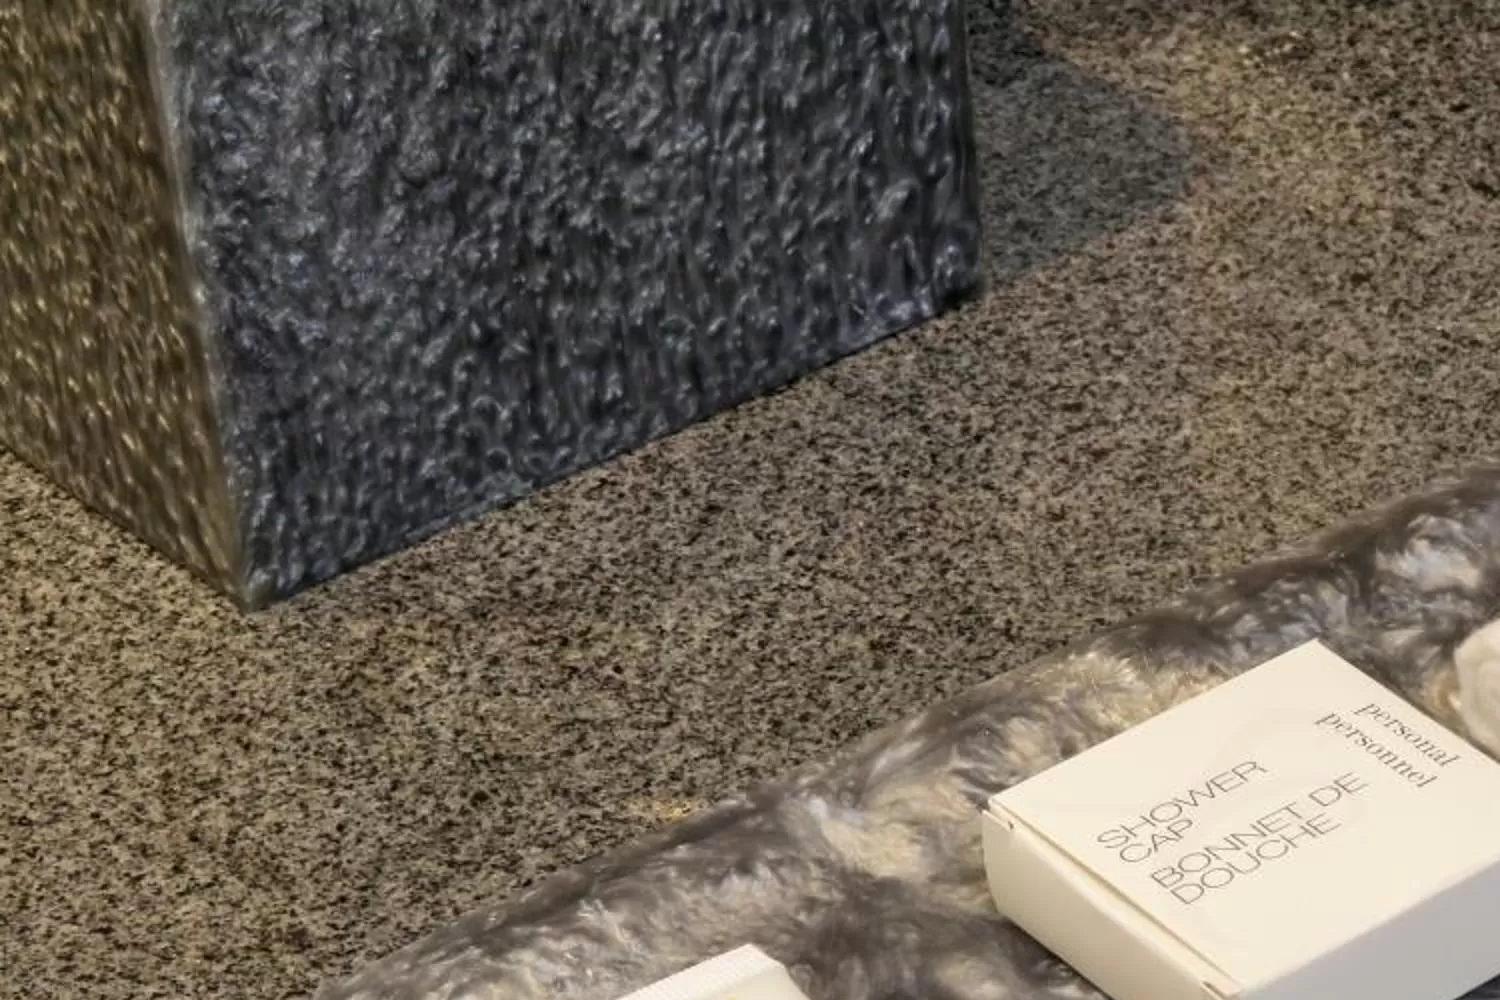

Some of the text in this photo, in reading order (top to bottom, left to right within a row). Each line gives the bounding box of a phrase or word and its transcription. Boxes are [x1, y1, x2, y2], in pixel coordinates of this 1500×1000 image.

[1314, 712, 1438, 788] personnel
[1351, 702, 1461, 768] personal
[1096, 760, 1269, 850] SHOWER
[1119, 818, 1194, 864] CAP
[1150, 771, 1369, 889] BONNET DE
[1170, 812, 1342, 905] DOUCHE
